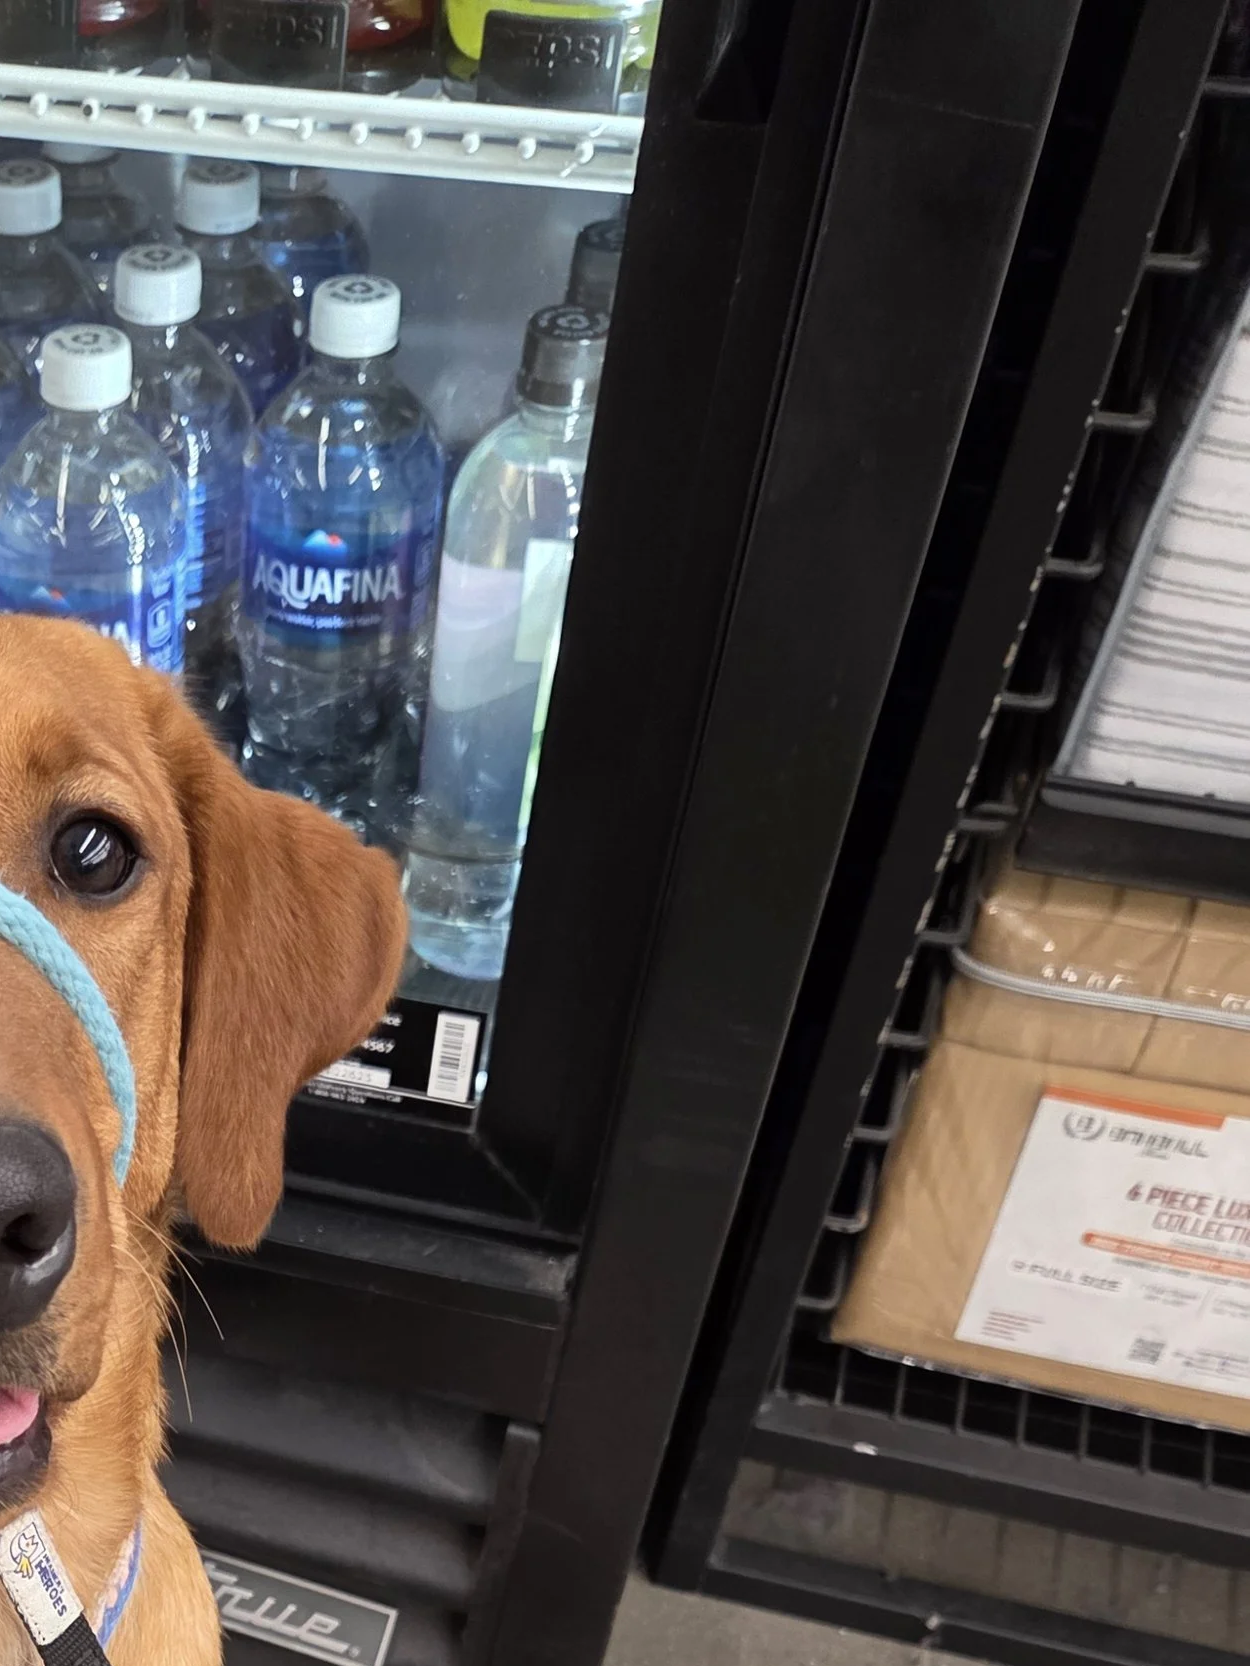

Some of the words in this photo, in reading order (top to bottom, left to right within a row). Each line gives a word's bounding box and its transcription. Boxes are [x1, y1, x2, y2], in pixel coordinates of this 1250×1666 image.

[252, 552, 401, 610] AQUAFINA
[1145, 1185, 1213, 1216] PIECE
[34, 1559, 68, 1618] HEROES
